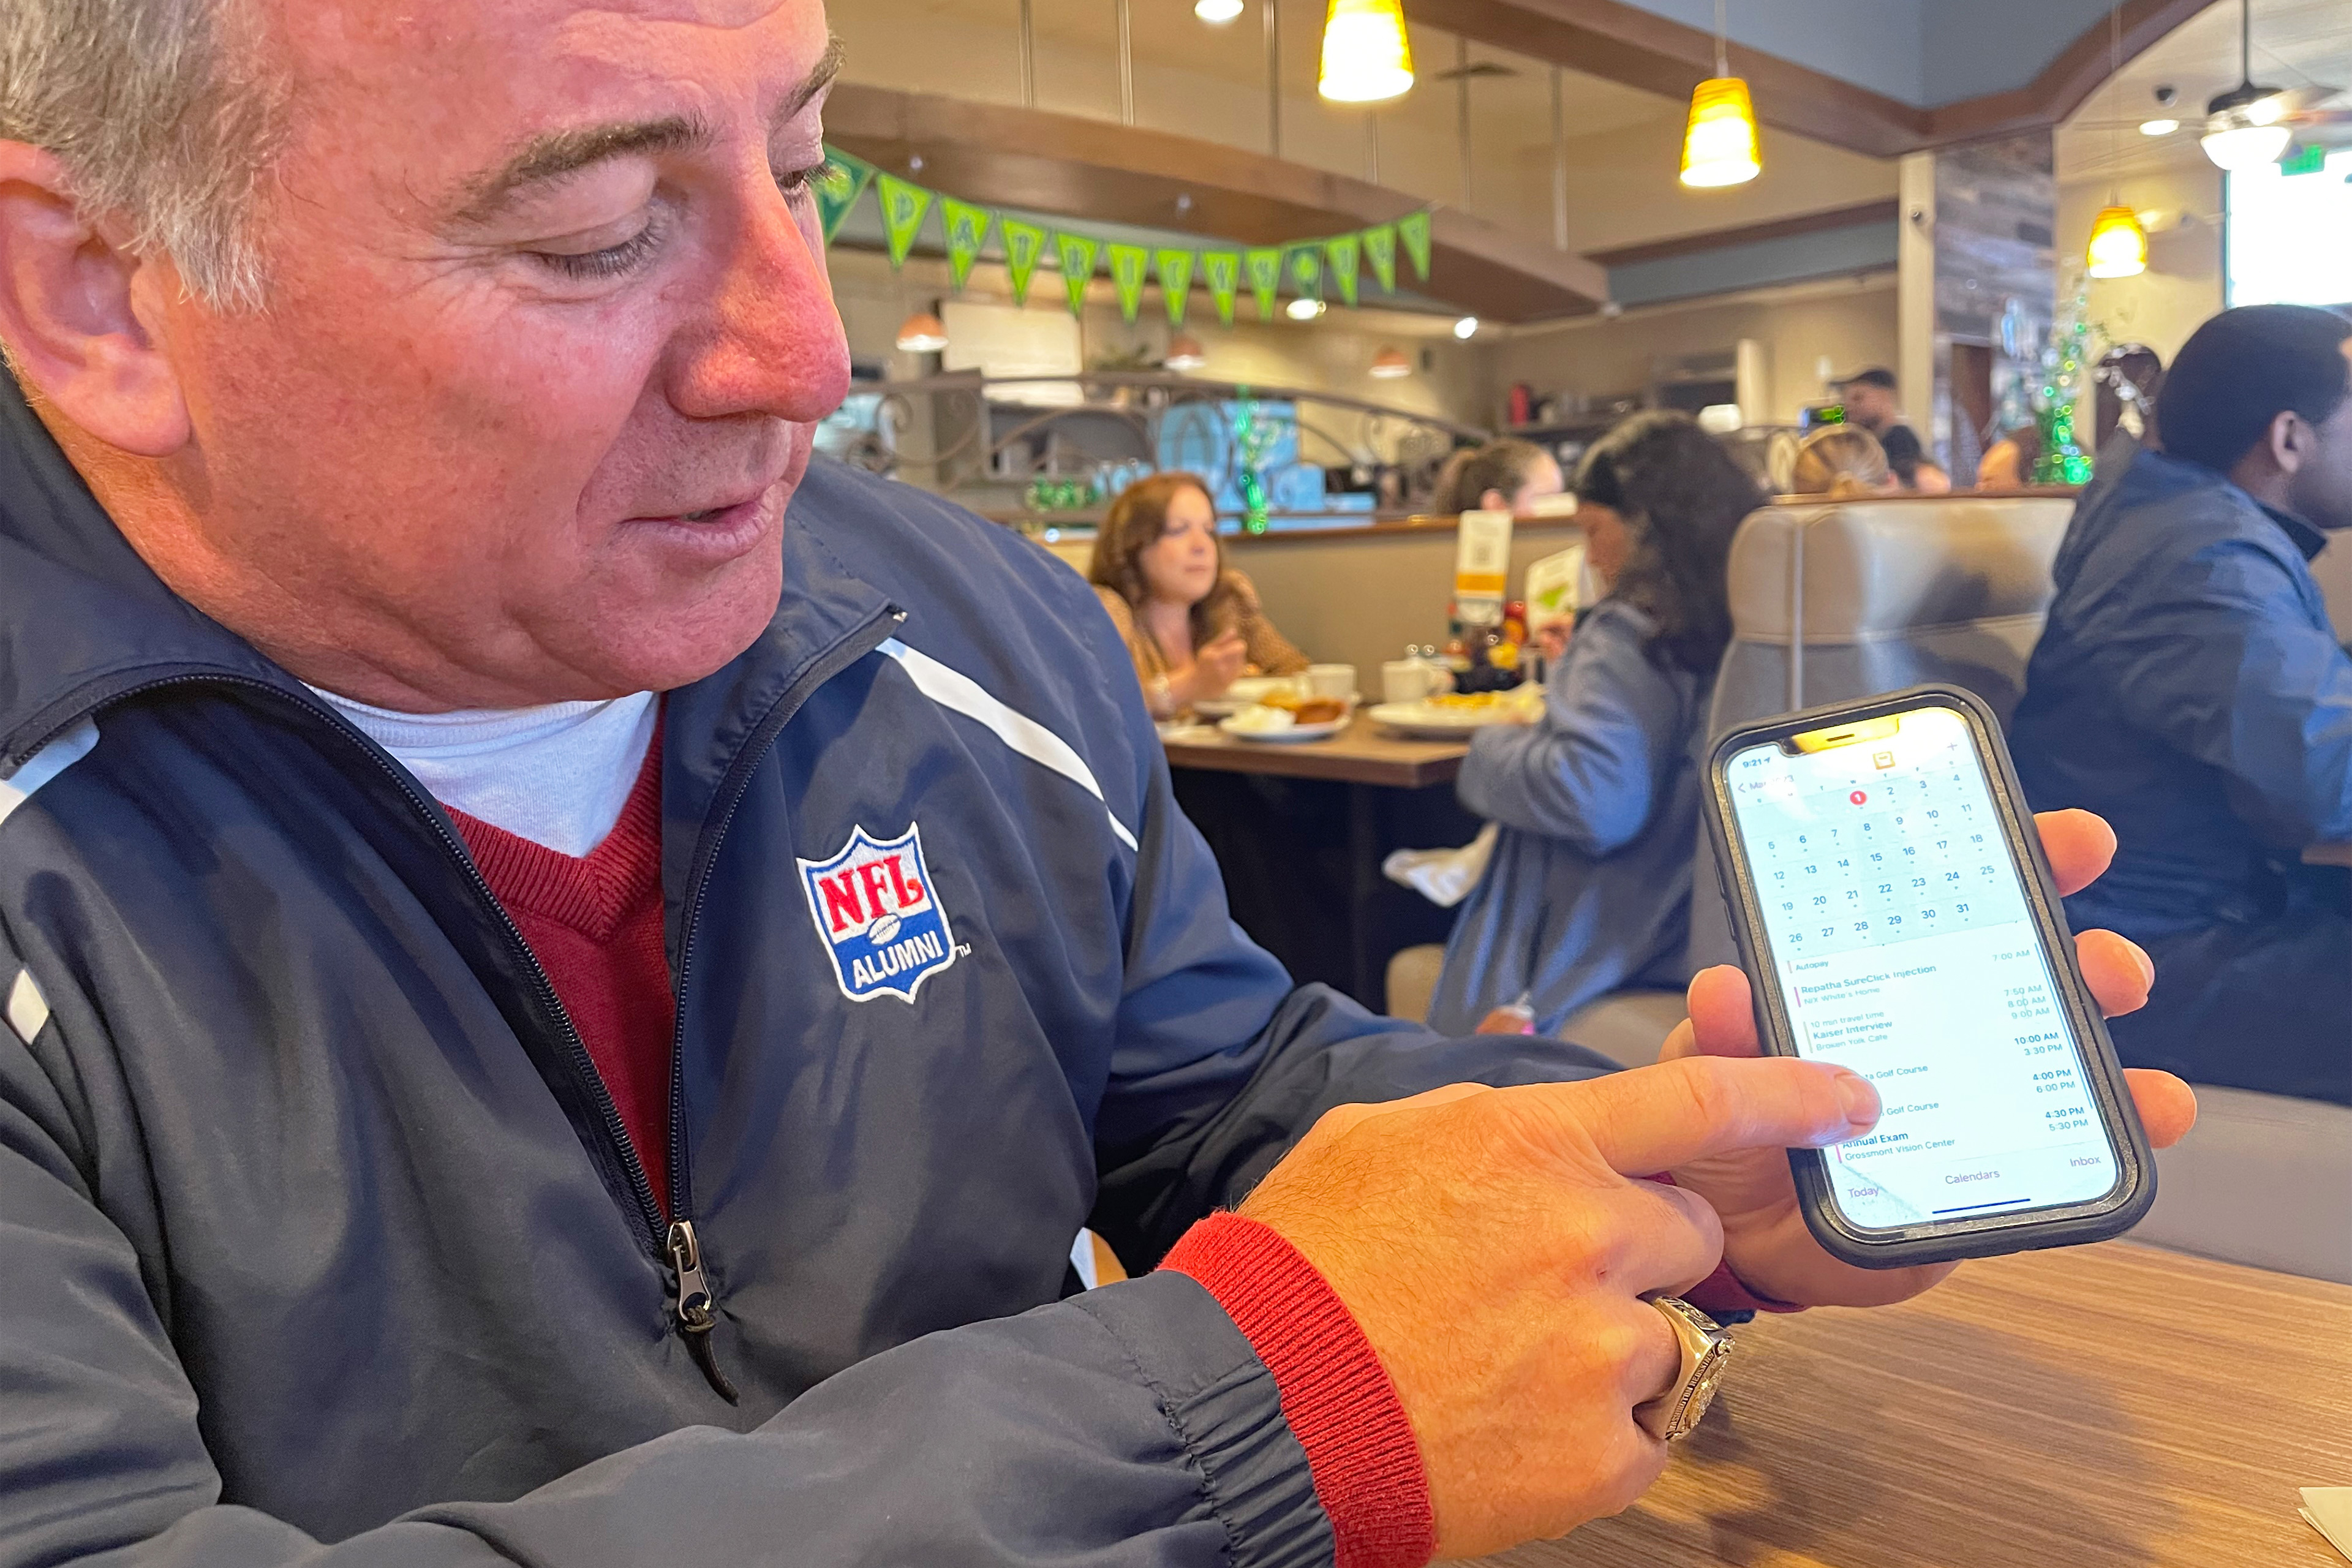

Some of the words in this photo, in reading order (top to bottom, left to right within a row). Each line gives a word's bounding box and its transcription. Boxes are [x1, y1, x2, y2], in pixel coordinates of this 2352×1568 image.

[1743, 758, 1762, 768] 9:21
[1887, 786, 1894, 795] 2
[1920, 780, 1928, 789] 3
[1768, 841, 1775, 850] 5
[1799, 835, 1807, 843] 6
[1831, 829, 1838, 837] 7
[1863, 823, 1871, 831] 8
[1896, 816, 1903, 825] 9
[1926, 810, 1939, 818] 10
[1961, 803, 1972, 812] 11
[1774, 871, 1785, 880] 12
[1805, 865, 1817, 873] 13
[1838, 859, 1849, 867] 14
[1870, 852, 1883, 862] 15
[1902, 846, 1916, 856] 16
[1936, 840, 1948, 850] 17
[1970, 834, 1984, 843] 18
[818, 854, 925, 933] NFL
[1782, 902, 1793, 911] 19
[1812, 895, 1827, 906] 20
[1845, 890, 1858, 899] 21
[1878, 883, 1893, 894] 22
[1911, 877, 1926, 888] 23
[1945, 871, 1960, 881] 24
[1980, 865, 1995, 875] 25
[1789, 933, 1803, 943] 26
[1821, 927, 1834, 937] 27
[1854, 921, 1869, 931] 28
[1887, 915, 1902, 925] 29
[1921, 909, 1936, 919] 30
[1956, 903, 1970, 913] 31
[852, 930, 944, 989] ALUMNI
[2016, 949, 2030, 958] AM
[1796, 960, 1830, 971] Autopay
[1801, 981, 1842, 994] Repatha
[1843, 974, 1891, 987] SureClick
[1893, 965, 1937, 979] Injection
[1855, 987, 1880, 997] Home
[2028, 984, 2043, 993] AM
[2032, 995, 2046, 1005] AM
[2035, 1007, 2050, 1016] AM
[1811, 1020, 1820, 1029] 10
[1840, 1014, 1864, 1023] travel
[1865, 1011, 1885, 1020] time
[1813, 1029, 1844, 1039] Kaiser
[1845, 1020, 1893, 1034] Interview
[2014, 1034, 2041, 1045] 10:00
[2043, 1031, 2059, 1041] AM
[2047, 1043, 2063, 1052] PM
[1875, 1069, 1894, 1079] Golf
[1896, 1065, 1929, 1076] Course
[2032, 1071, 2054, 1081] 4:00
[2055, 1068, 2072, 1078] PM
[2060, 1080, 2076, 1090] PM
[1886, 1106, 1905, 1116] Golf
[1907, 1101, 1940, 1113] Course
[2045, 1109, 2067, 1119] 4:30
[2068, 1106, 2085, 1116] PM
[2048, 1121, 2071, 1132] 5:30
[2073, 1118, 2089, 1128] PM
[1879, 1133, 1909, 1144] Exam
[1844, 1147, 1894, 1161] Grossmont
[1895, 1143, 1924, 1153] Vision
[1924, 1138, 1956, 1150] Center
[1848, 1186, 1880, 1199] Today
[1944, 1169, 2001, 1185] Calendars
[2069, 1156, 2102, 1167] Inbox
